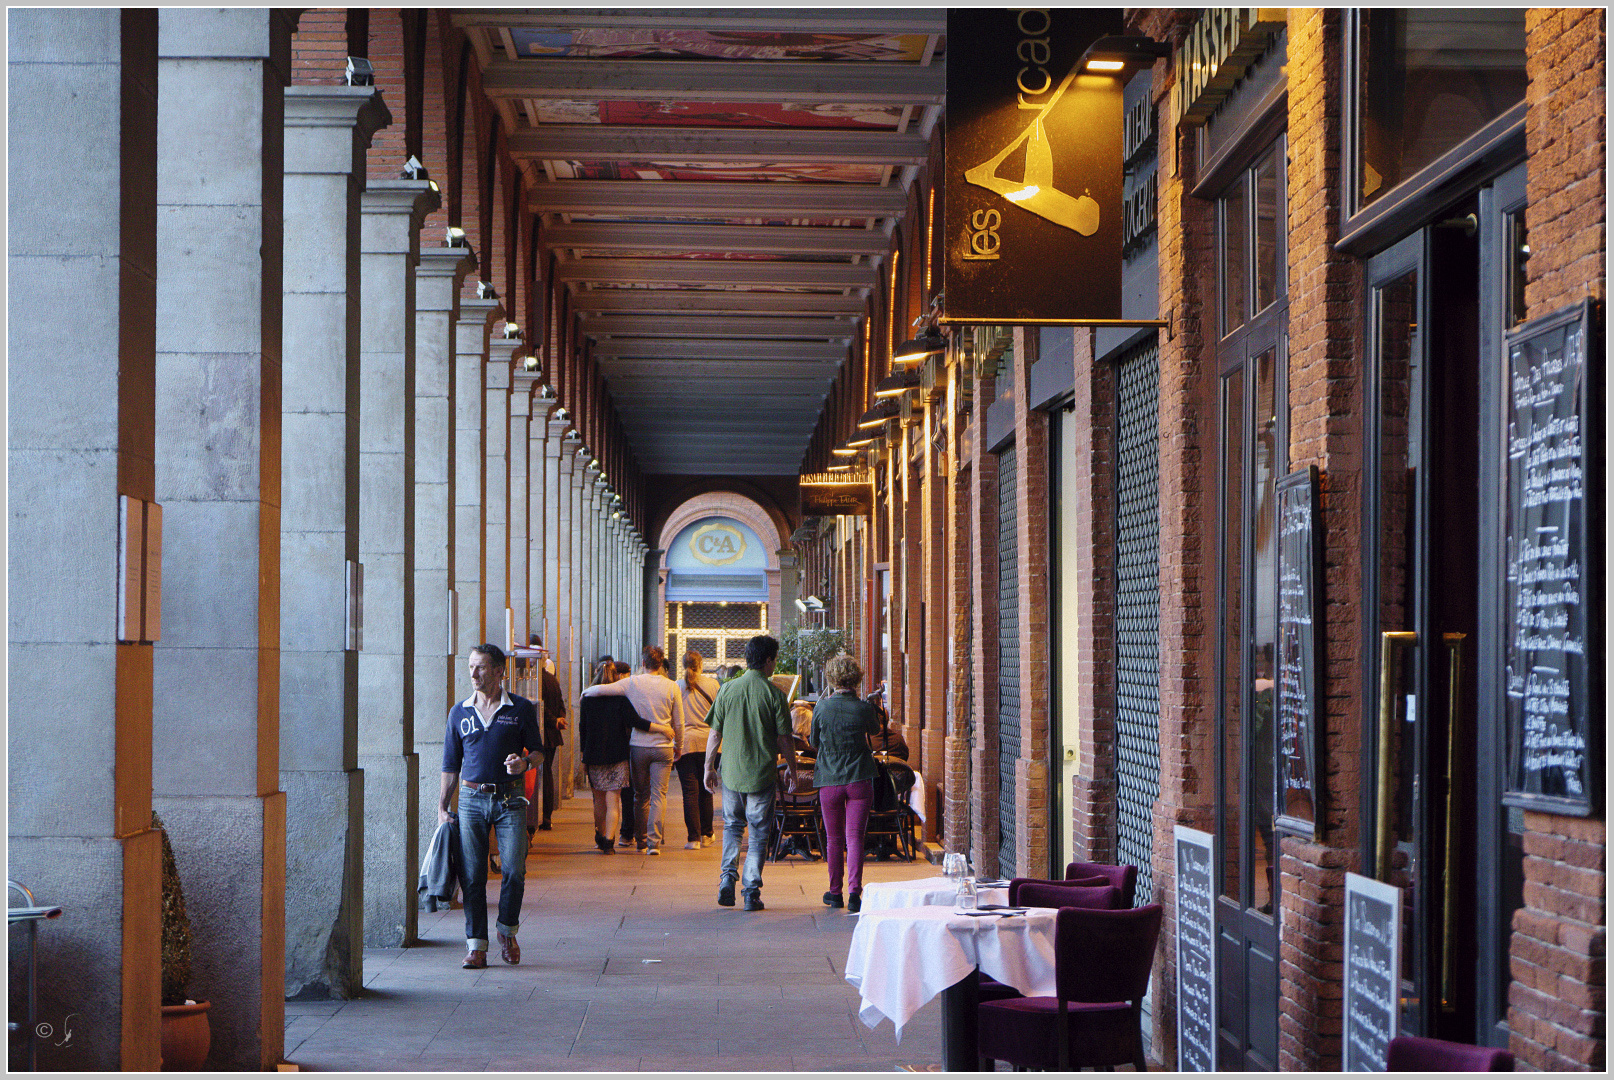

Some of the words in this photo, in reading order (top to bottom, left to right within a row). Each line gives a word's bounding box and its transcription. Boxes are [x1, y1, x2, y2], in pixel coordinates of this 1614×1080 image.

[1122, 88, 1154, 163] ILLERIE
[962, 209, 1002, 261] les
[698, 535, 737, 554] C&A
